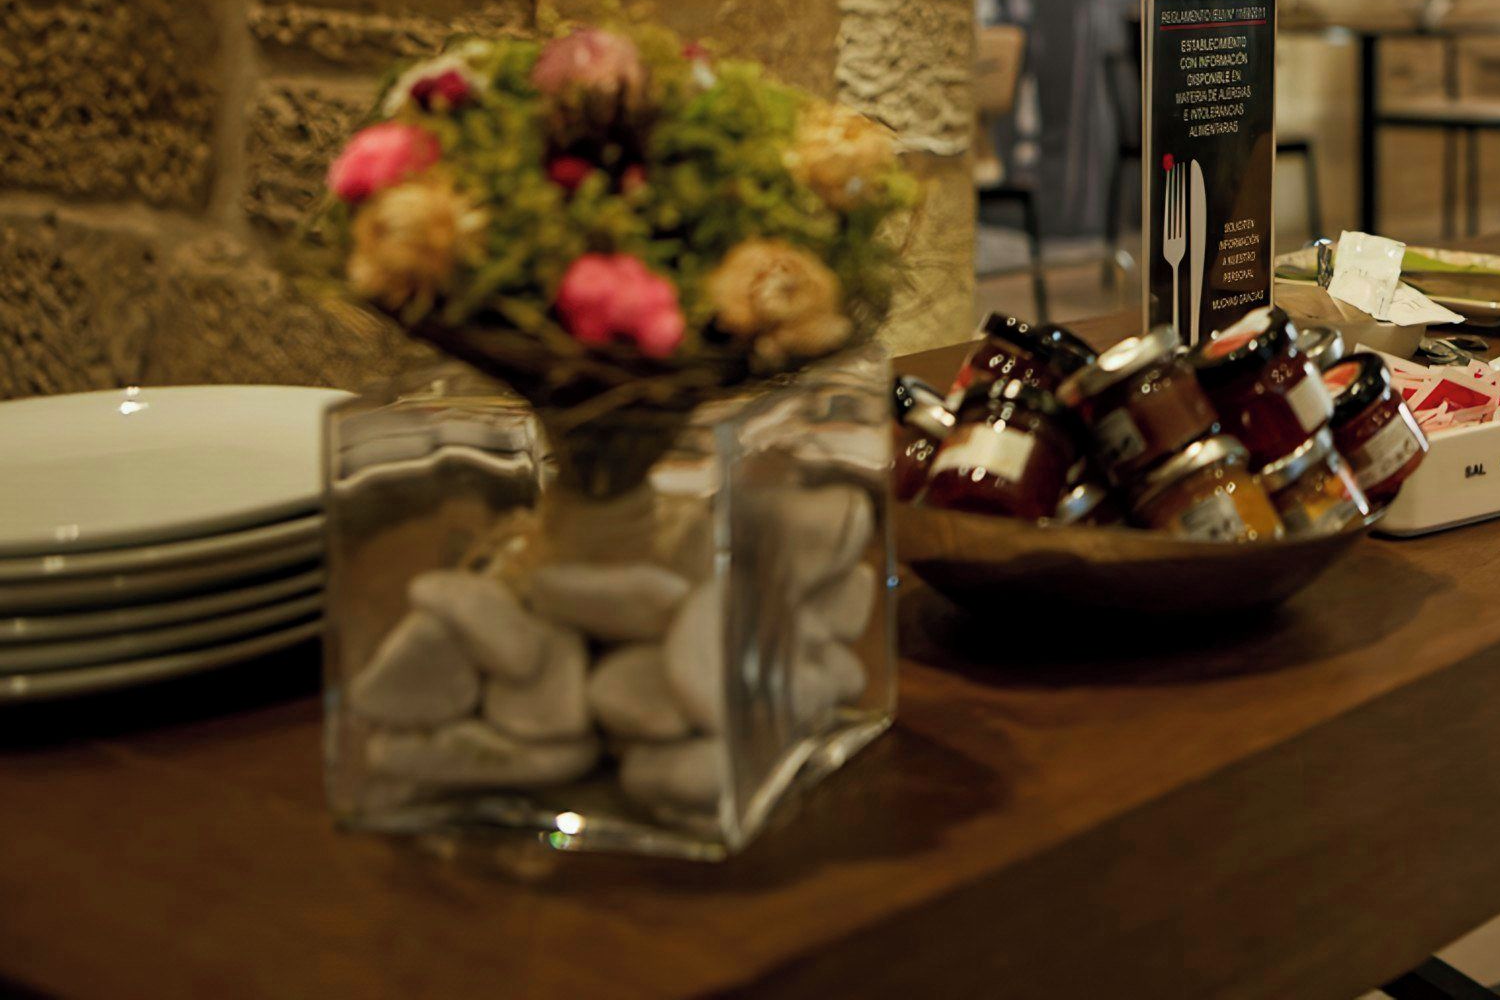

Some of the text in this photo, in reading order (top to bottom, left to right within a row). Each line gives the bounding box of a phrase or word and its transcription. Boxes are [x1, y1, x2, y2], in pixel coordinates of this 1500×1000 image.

[1180, 57, 1197, 70] CON
[1187, 70, 1231, 86] DISPONIBLE
[1208, 88, 1218, 102] DE
[1464, 463, 1486, 479] SAL
